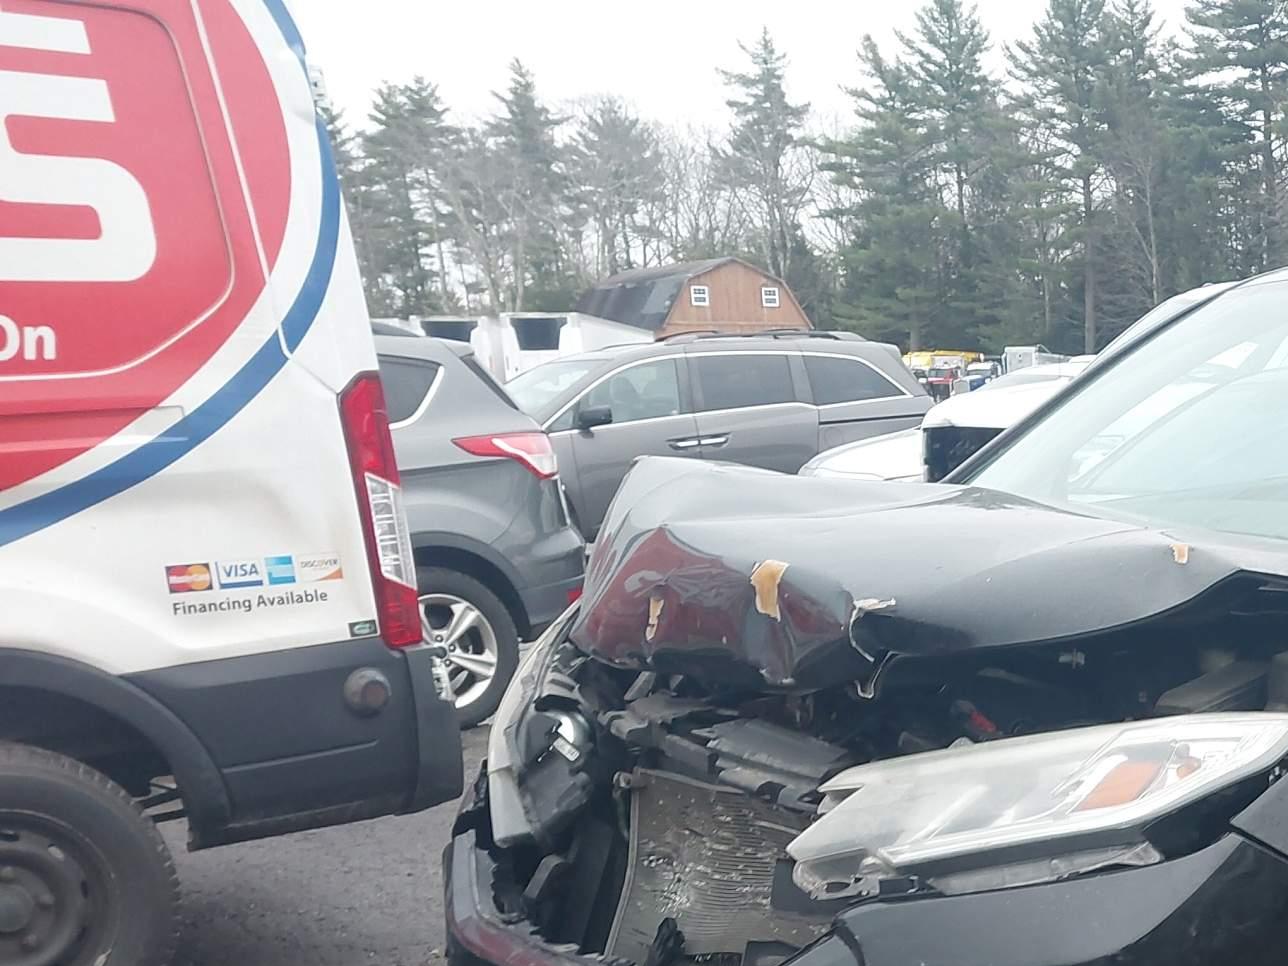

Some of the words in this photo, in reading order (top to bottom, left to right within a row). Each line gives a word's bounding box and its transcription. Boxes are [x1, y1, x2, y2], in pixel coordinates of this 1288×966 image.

[223, 563, 260, 578] VISA
[172, 597, 252, 616] Financing
[256, 589, 328, 607] Available
